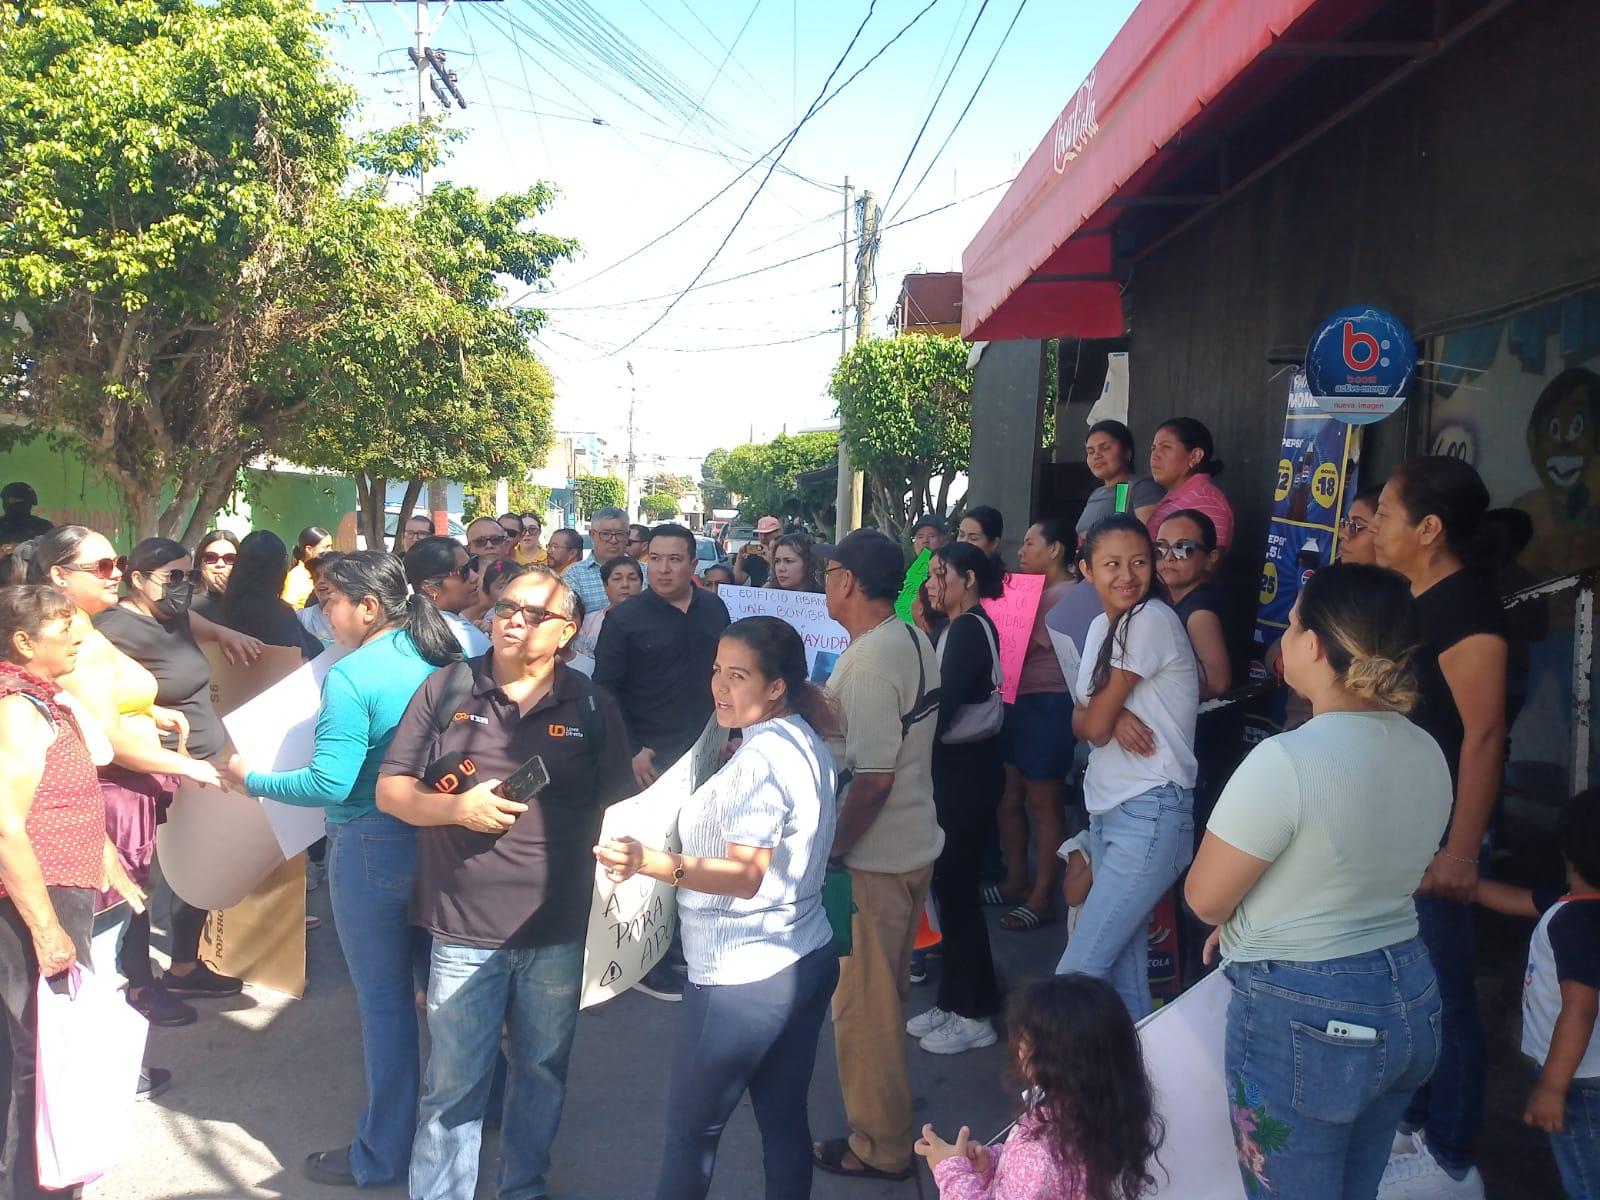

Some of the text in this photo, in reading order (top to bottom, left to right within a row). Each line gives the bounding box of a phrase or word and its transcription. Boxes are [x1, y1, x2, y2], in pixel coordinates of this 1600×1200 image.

[1333, 402, 1385, 410] nueva imagen
[738, 589, 789, 603] EDIFICIO
[738, 603, 767, 615] UNA
[776, 604, 827, 621] BOMBA
[602, 892, 621, 918] A
[608, 895, 664, 949] PARA
